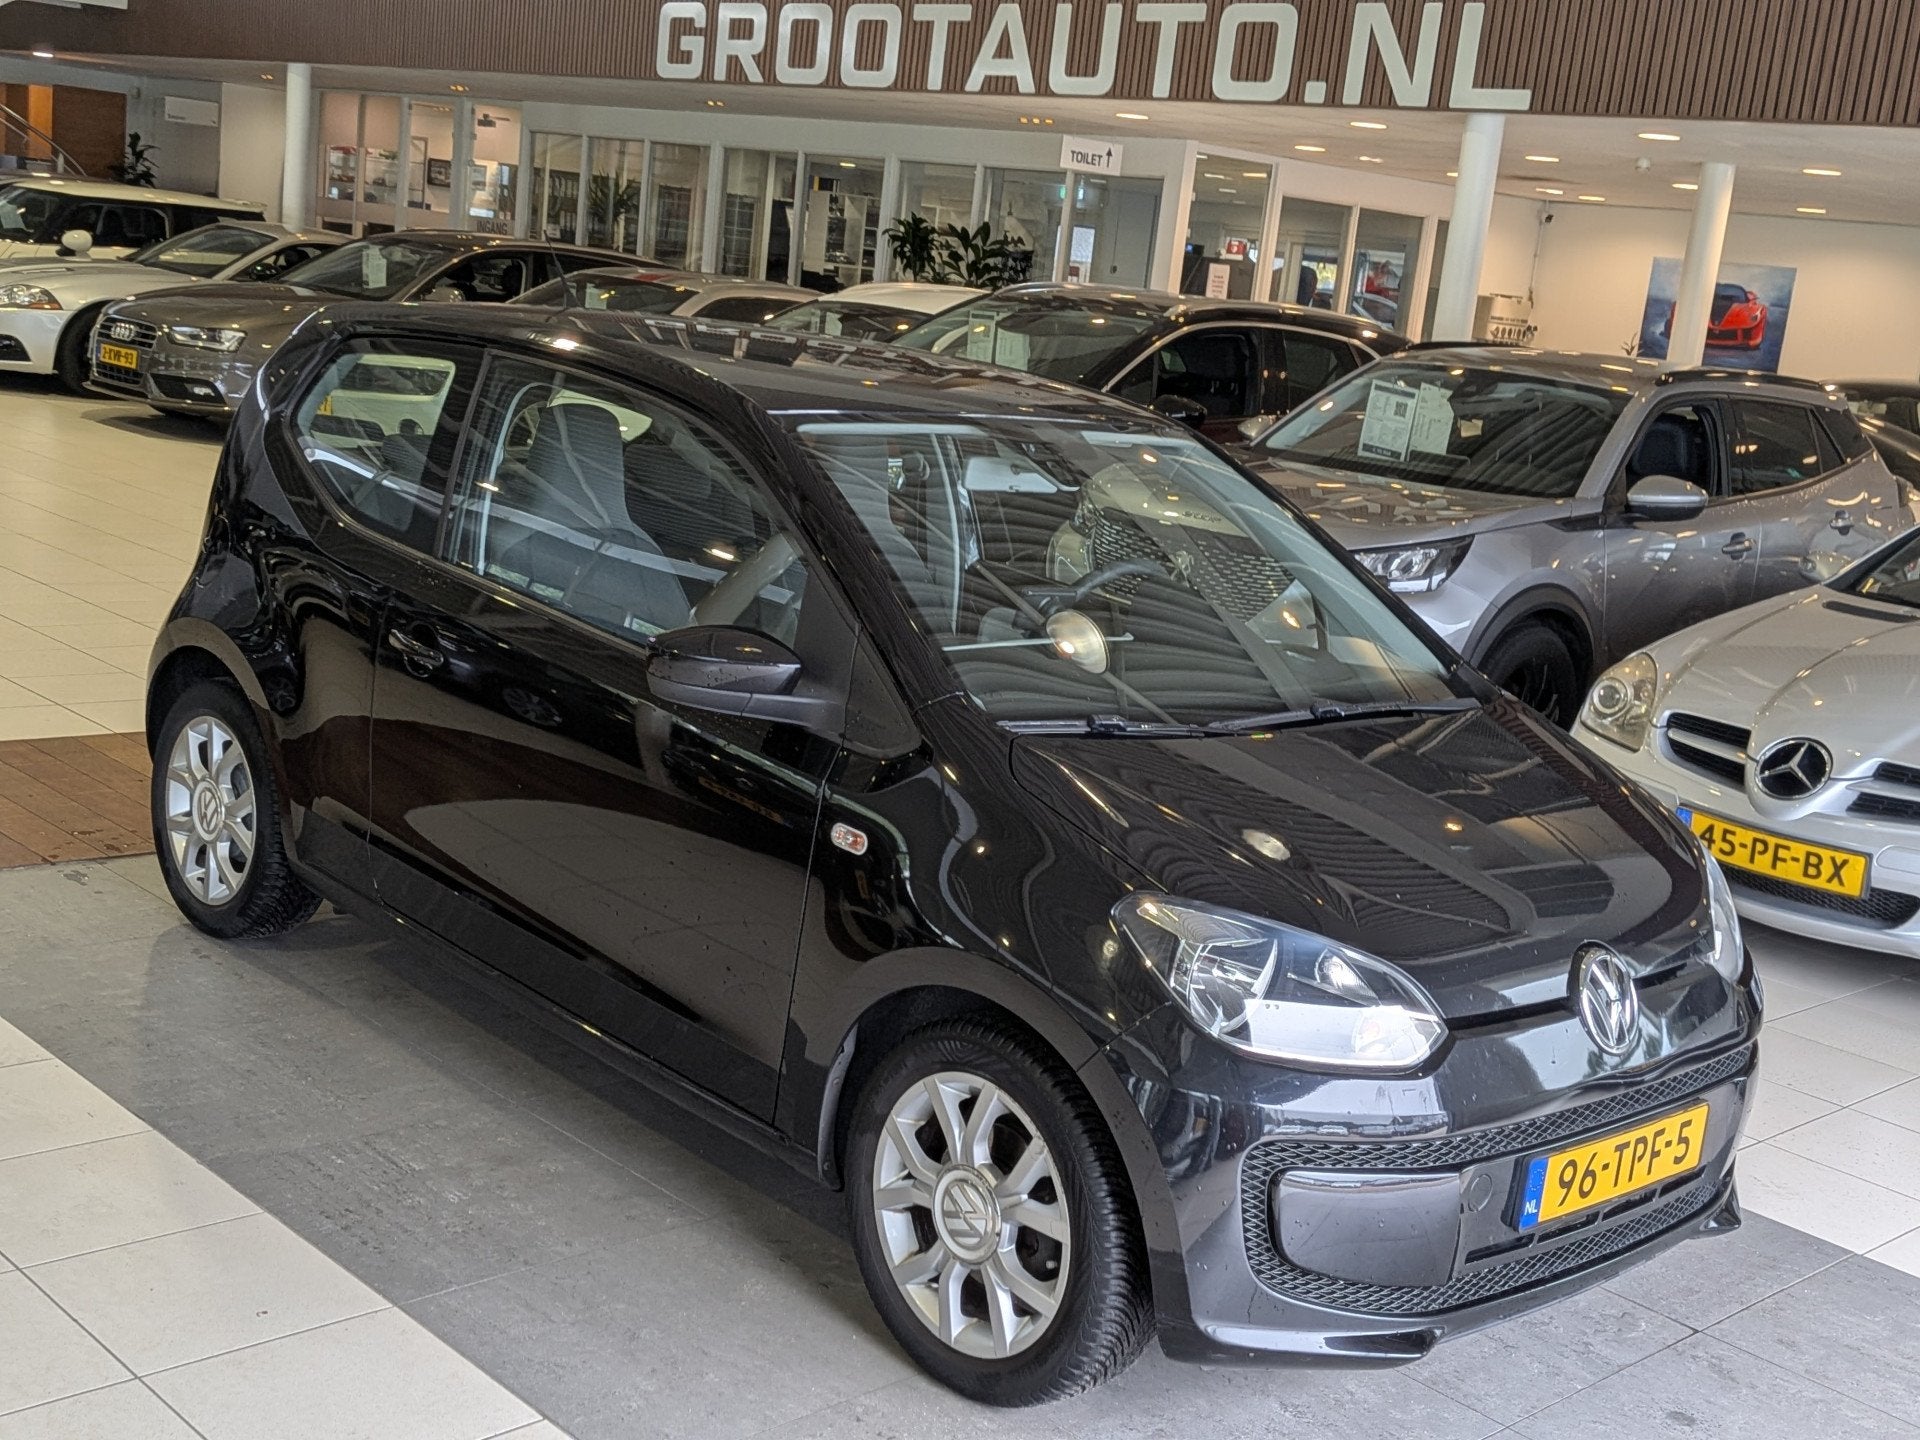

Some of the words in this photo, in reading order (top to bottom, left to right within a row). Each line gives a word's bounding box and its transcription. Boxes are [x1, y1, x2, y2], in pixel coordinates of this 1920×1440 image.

[656, 2, 1532, 110] GROOTAUTO.NL
[1070, 150, 1103, 167] TOILET
[476, 220, 508, 235] INGANG
[1699, 823, 1849, 887] 45-PF-BX
[1557, 1119, 1693, 1208] 96-TPF-5
[1524, 1199, 1538, 1215] NL
